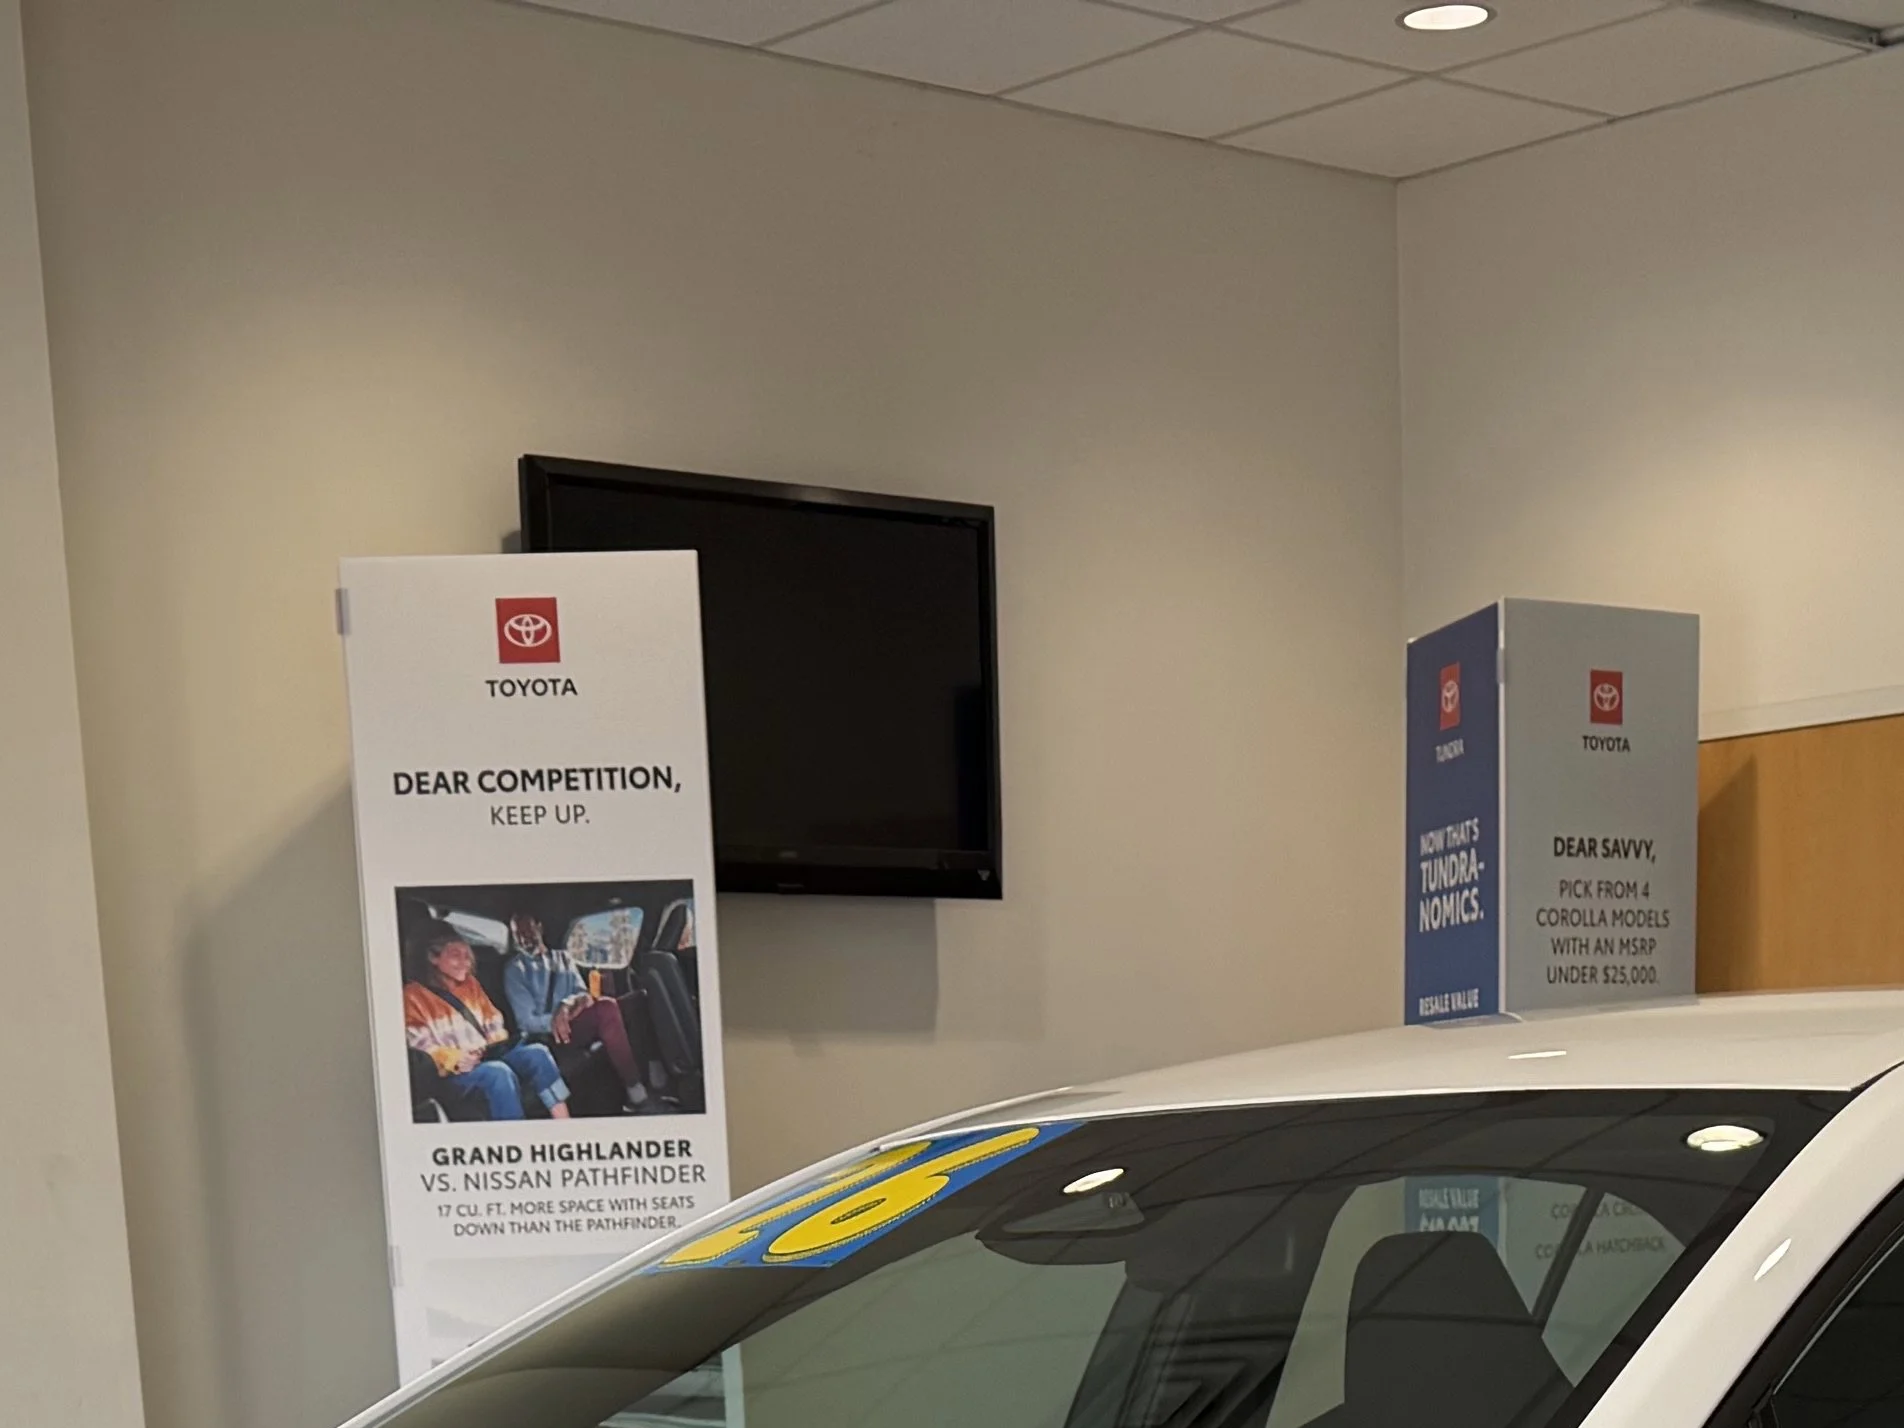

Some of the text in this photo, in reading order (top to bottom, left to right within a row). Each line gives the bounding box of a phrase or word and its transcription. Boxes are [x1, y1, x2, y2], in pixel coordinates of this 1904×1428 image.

[485, 678, 578, 698] TOYOTA
[1582, 735, 1631, 752] TOYOTA
[393, 766, 682, 796] DEAR COMPETITION,
[490, 804, 590, 826] KEEP UP.
[1420, 817, 1480, 856] NOW THAT'S
[1554, 836, 1656, 863] DEAR SAVVY,
[1420, 847, 1484, 893] TUNDRA-
[1559, 880, 1650, 899] PICK FROM 4
[1419, 887, 1484, 933] NOMICS.
[1536, 908, 1670, 928] COROLLA MODELS
[1551, 937, 1657, 956] WITH AN MSRP
[1547, 965, 1659, 986] UNDER $25,000.
[432, 1139, 693, 1166] GRAND HIGHLANDER
[420, 1164, 707, 1192] VS. NISSAN PATHFINDER
[438, 1195, 696, 1217] 17 CU. FT. MORE SPACE WITH SEATS
[454, 1215, 682, 1237] DOWN THAN THE PATHFINDER.
